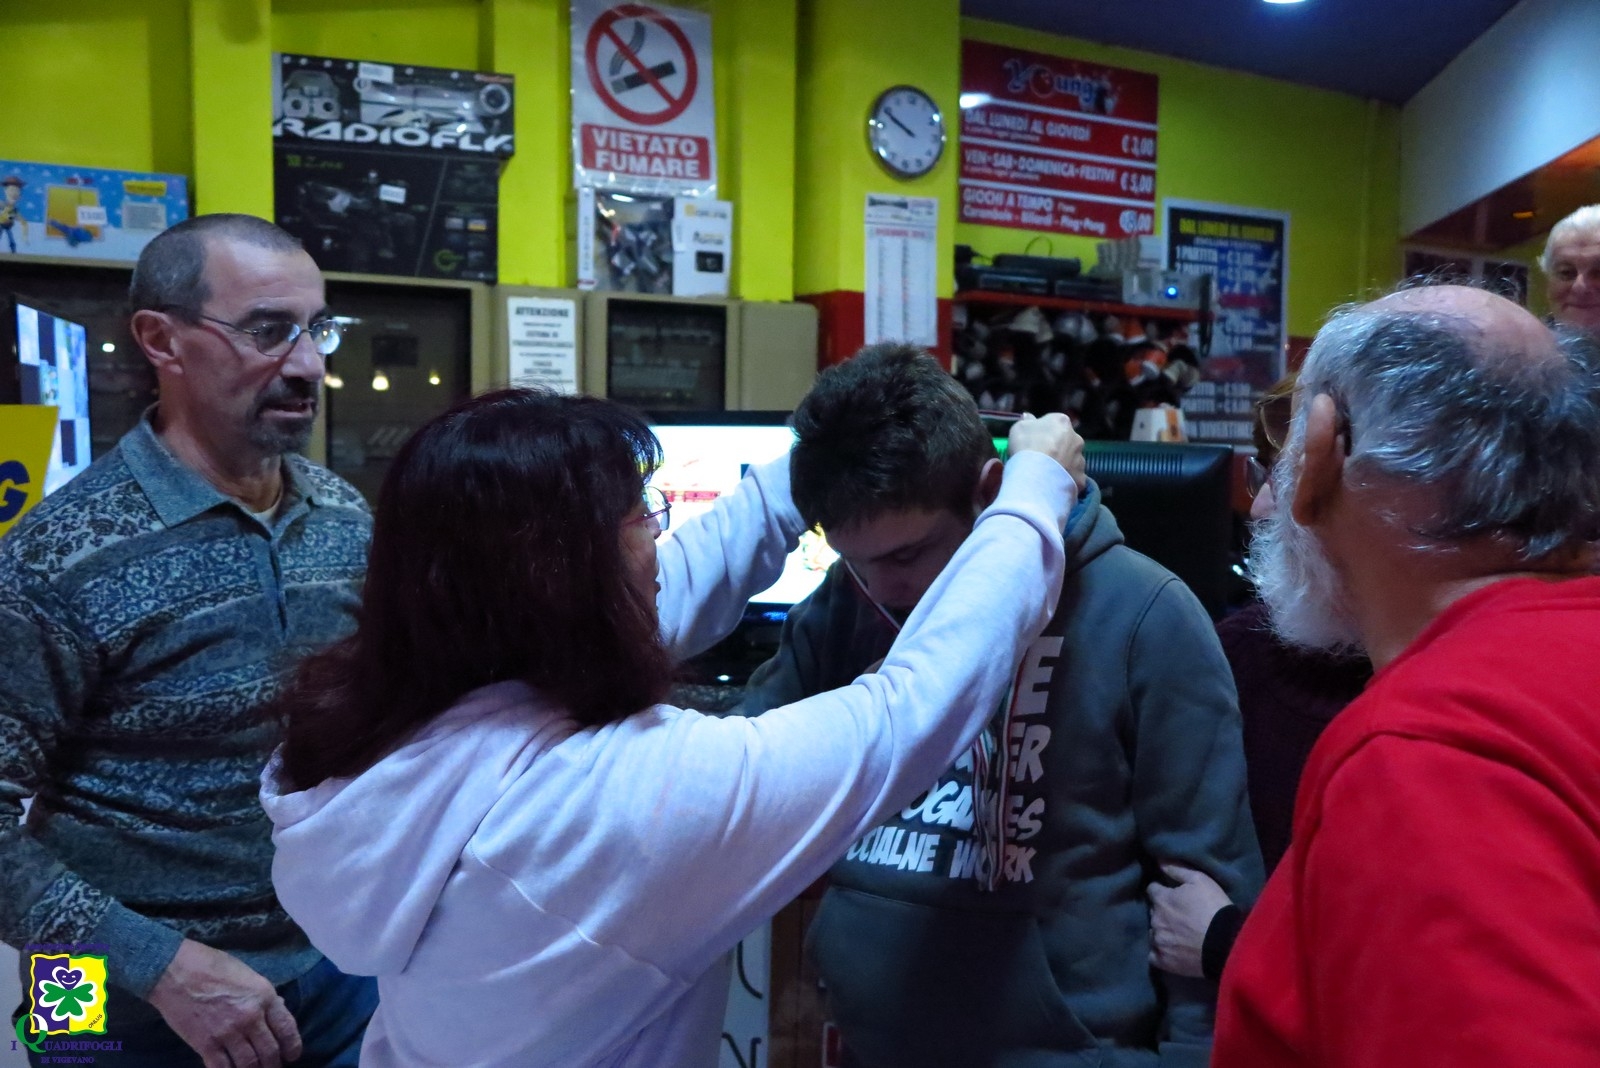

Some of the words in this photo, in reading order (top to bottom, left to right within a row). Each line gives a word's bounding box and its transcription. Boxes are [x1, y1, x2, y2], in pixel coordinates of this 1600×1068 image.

[964, 109, 986, 125] DAL
[1030, 119, 1044, 134] AL
[273, 118, 513, 152] RADIOFLY
[592, 128, 698, 157] VIETATO
[594, 150, 701, 178] FUMARE
[963, 188, 1004, 205] GIOCHI
[1006, 193, 1015, 206] A
[1017, 194, 1053, 211] TEMPO
[515, 306, 569, 318] ATTENZIONE
